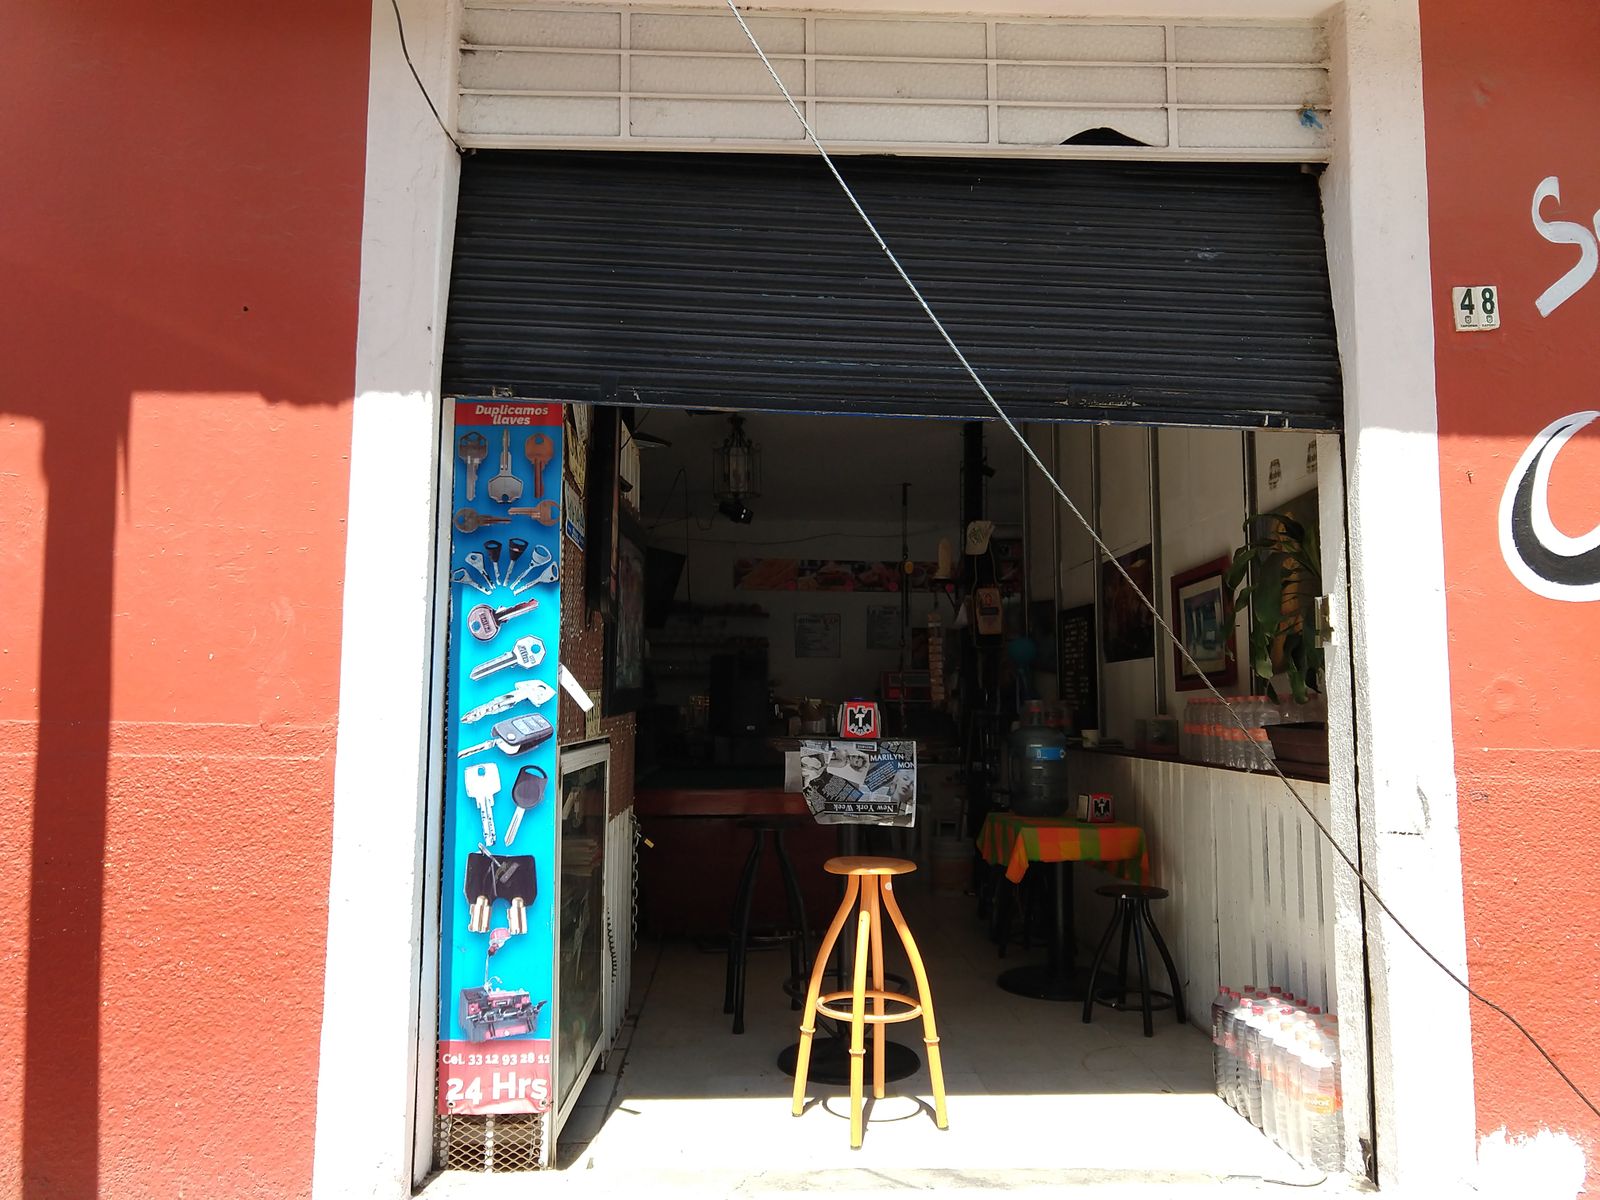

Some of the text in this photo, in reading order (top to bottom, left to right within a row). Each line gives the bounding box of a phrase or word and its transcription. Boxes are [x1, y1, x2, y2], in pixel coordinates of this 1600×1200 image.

[1532, 176, 1600, 317] S
[1460, 288, 1495, 314] 48
[475, 405, 548, 417] Duplicamos
[492, 415, 531, 425] llaves
[870, 754, 904, 762] MARILYN
[856, 804, 874, 812] York
[468, 1053, 483, 1066] 33
[485, 1054, 500, 1065] 12
[501, 1053, 518, 1066] 93
[519, 1052, 536, 1064] 28
[537, 1053, 551, 1065] 11
[446, 1072, 548, 1104] 24 Hrs
